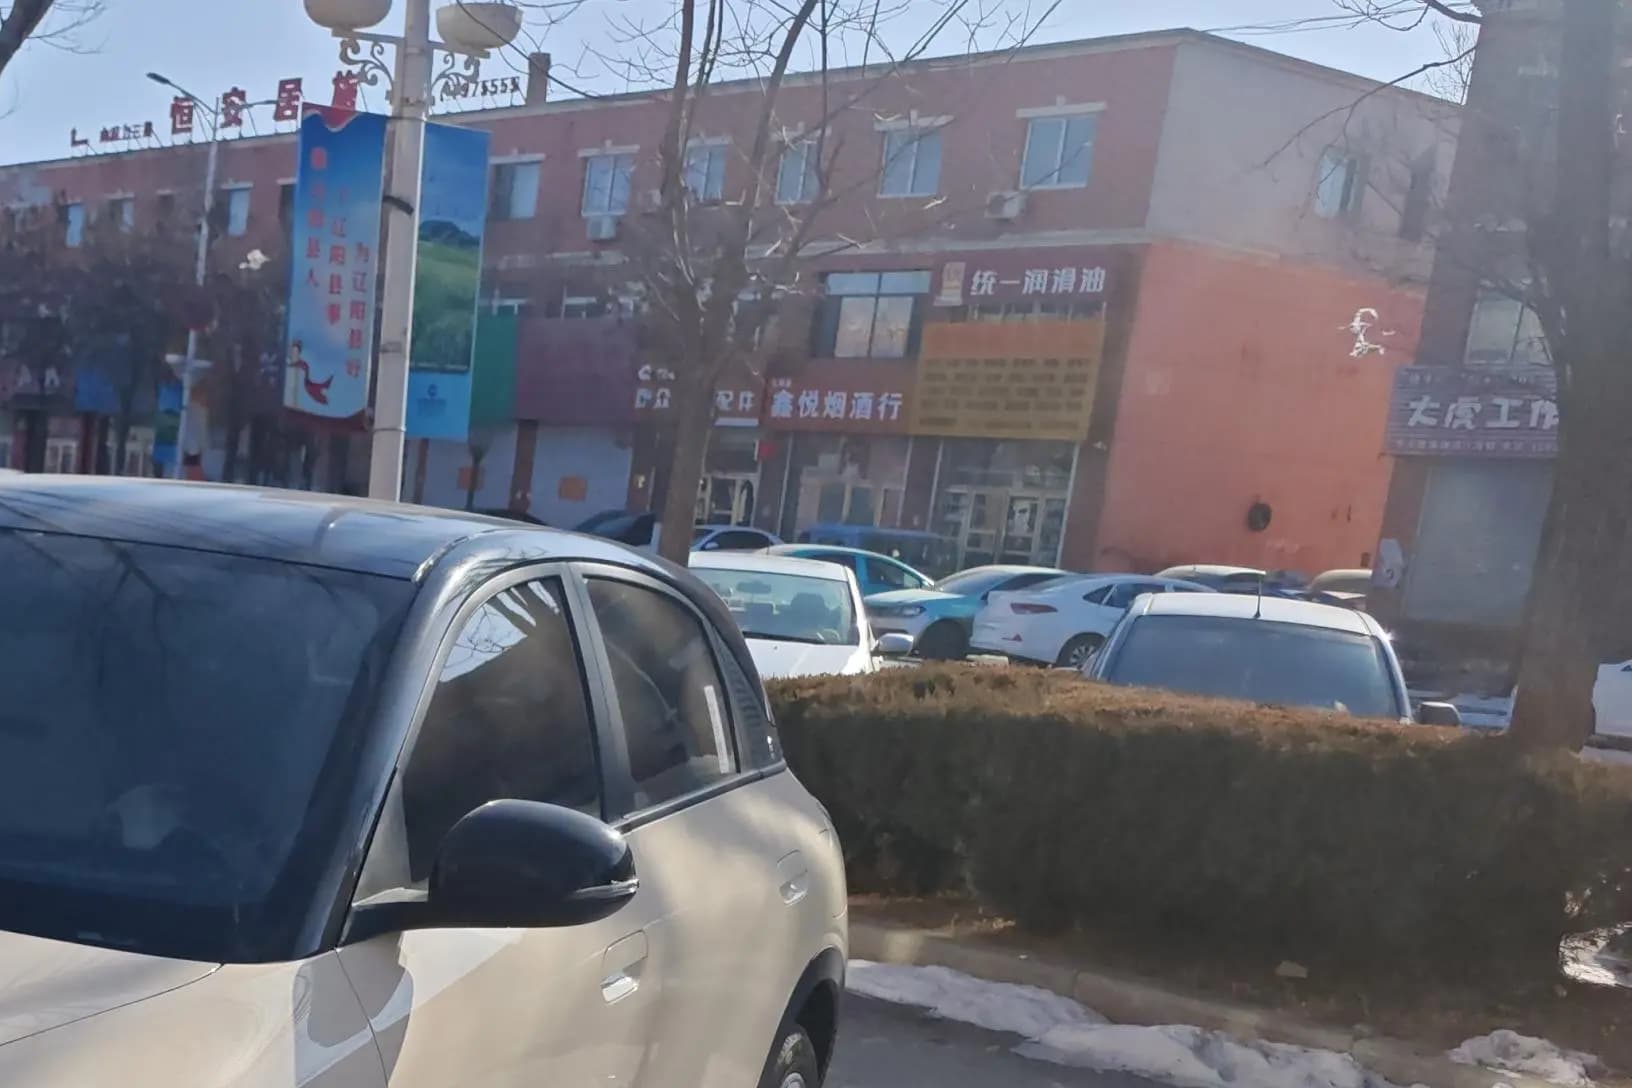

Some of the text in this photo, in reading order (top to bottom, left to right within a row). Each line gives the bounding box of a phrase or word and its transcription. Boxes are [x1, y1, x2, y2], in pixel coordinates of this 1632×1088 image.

[970, 267, 1106, 296] 统一润滑油
[770, 388, 904, 421] 鑫悦烟酒行
